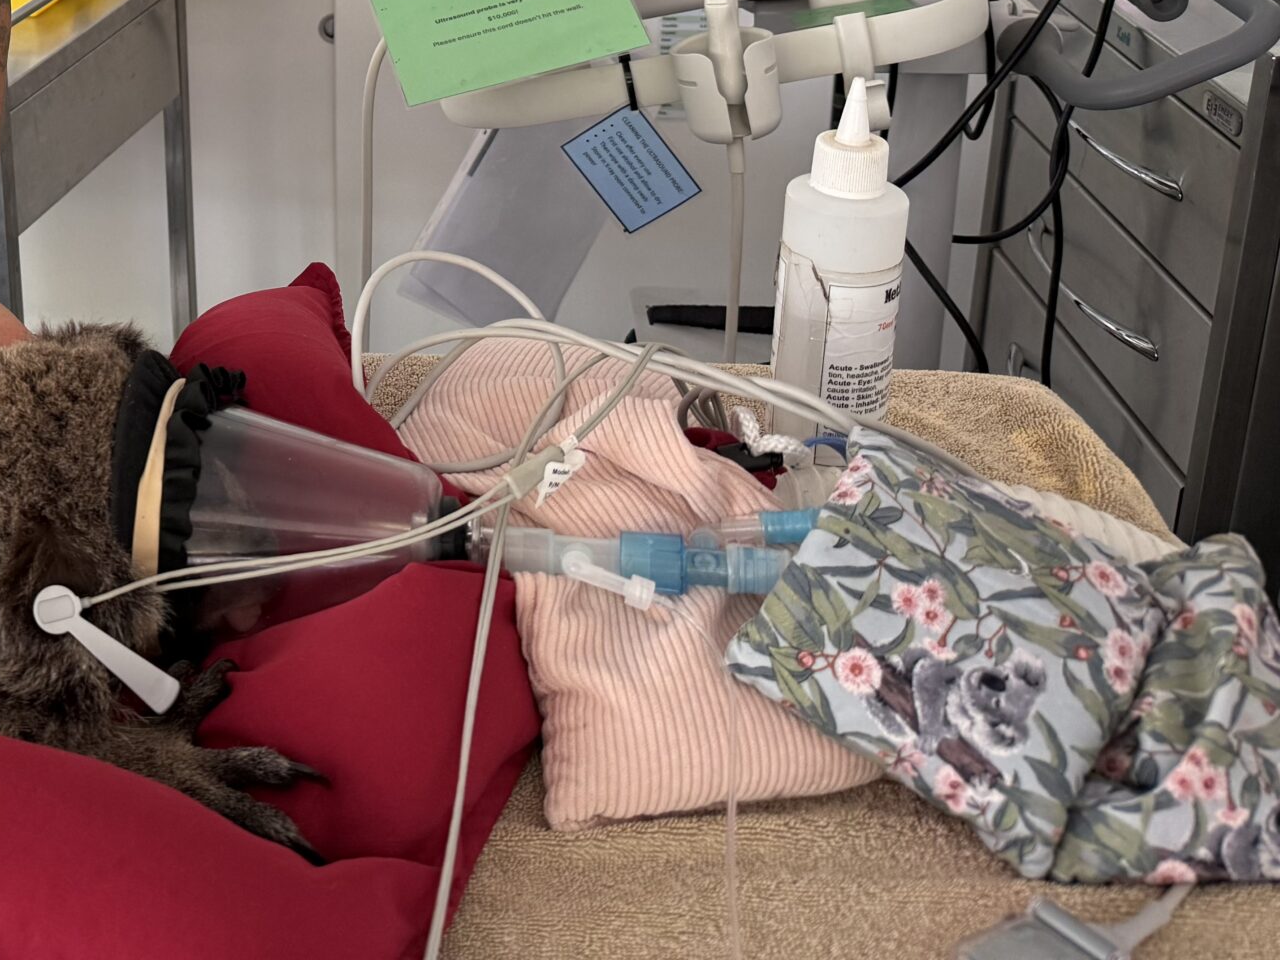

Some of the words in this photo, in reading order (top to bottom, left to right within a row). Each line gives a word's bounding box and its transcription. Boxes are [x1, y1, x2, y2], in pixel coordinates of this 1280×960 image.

[432, 38, 457, 47] Please
[457, 31, 482, 41] ensure
[482, 26, 497, 34] this
[497, 22, 514, 31] cord
[514, 14, 542, 26] doesn't
[542, 11, 553, 19] hit
[552, 8, 565, 16] the
[434, 10, 476, 24] Ultrasound
[476, 4, 498, 14] probe
[614, 130, 628, 146] Clean
[624, 142, 637, 157] after
[632, 154, 646, 169] every
[642, 166, 652, 177] use
[620, 115, 642, 141] CLEANING
[638, 138, 650, 150] THE
[645, 147, 672, 180] ULTRASOUND
[590, 145, 604, 161] Store
[612, 173, 625, 188] room
[621, 185, 642, 211] connected
[598, 140, 611, 154] Then
[606, 152, 619, 166] wipe
[616, 163, 628, 176] with
[625, 176, 640, 192] damp
[636, 189, 649, 203] swab
[606, 135, 619, 149] First
[620, 153, 637, 172] alcohol
[633, 169, 644, 181] and
[639, 178, 652, 193] allow
[652, 195, 663, 207] dry
[827, 378, 851, 387] Acute
[858, 377, 872, 387] Eye:
[828, 363, 853, 372] Acute
[828, 372, 844, 380] tion,
[826, 393, 850, 401] Acute
[856, 393, 873, 401] Skin:
[549, 481, 560, 489] P/N
